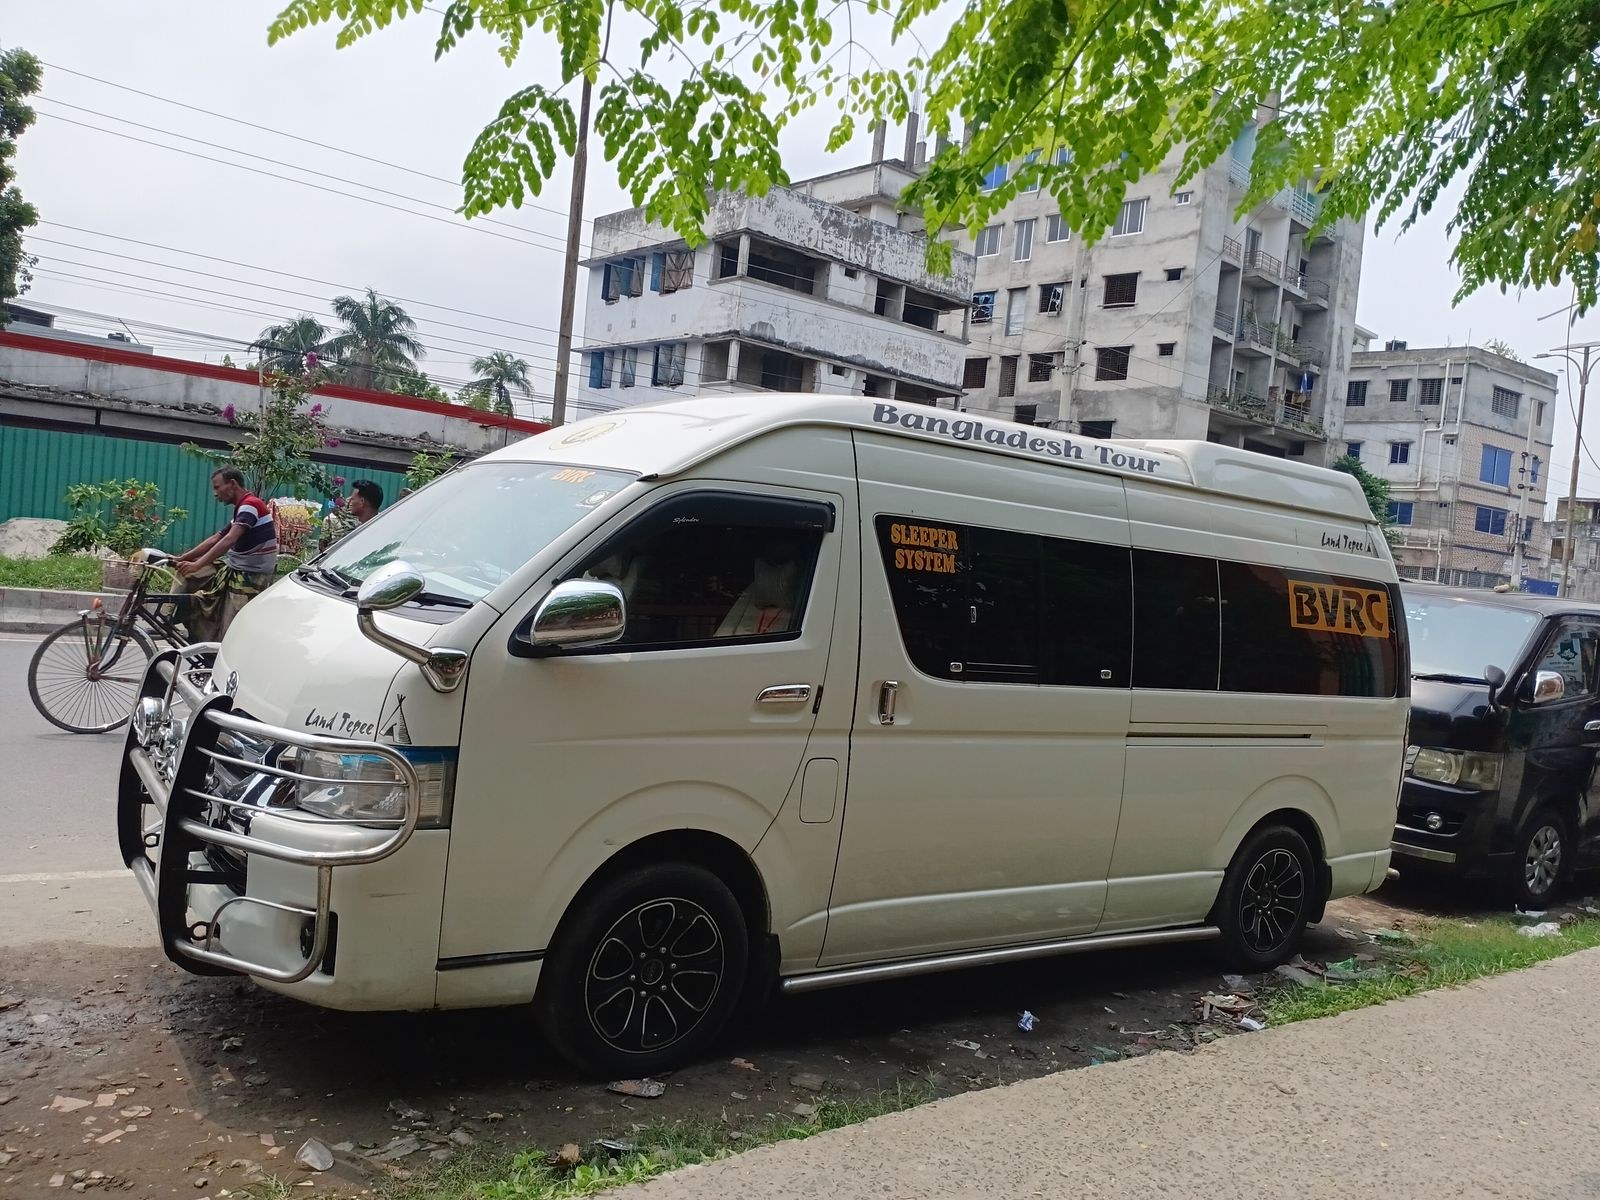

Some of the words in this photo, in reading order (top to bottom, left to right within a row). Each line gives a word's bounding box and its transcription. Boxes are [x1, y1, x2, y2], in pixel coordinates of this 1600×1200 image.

[873, 403, 1083, 460] Bangladesh
[1094, 445, 1160, 473] Tour
[891, 523, 958, 550] SLEEPER
[1321, 532, 1340, 549] Land
[1343, 535, 1364, 553] Tepee
[895, 549, 956, 574] SYSTEM
[1293, 584, 1384, 635] BVRC
[305, 708, 338, 731] Land
[339, 712, 374, 738] Tepee
